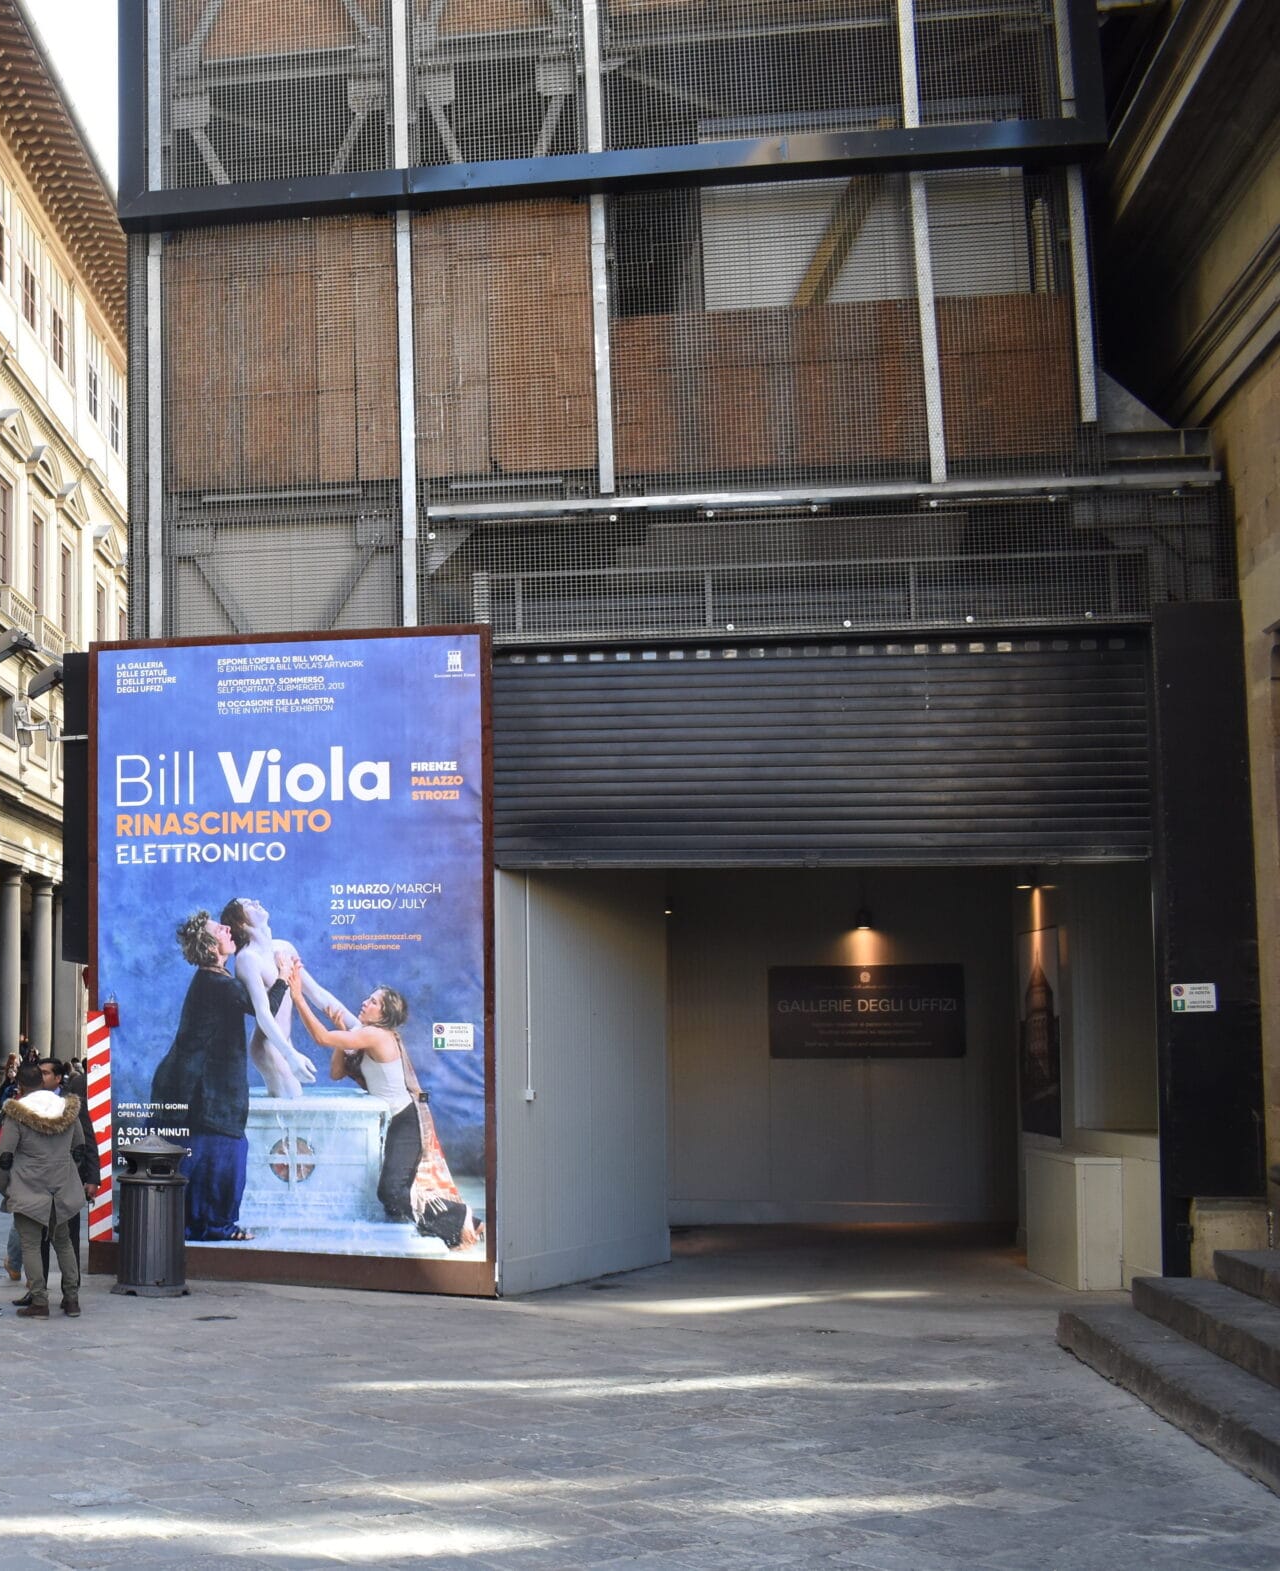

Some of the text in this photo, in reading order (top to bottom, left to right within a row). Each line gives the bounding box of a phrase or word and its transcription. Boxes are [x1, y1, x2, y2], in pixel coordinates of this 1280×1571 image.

[217, 658, 247, 666] ESPONE
[249, 656, 280, 664] L'OPERA
[309, 654, 334, 662] VIOLA
[226, 664, 268, 672] EXHIBITING
[294, 662, 322, 670] VIOLA'S
[324, 660, 364, 668] ARTWORK
[116, 670, 138, 678] DELLE
[147, 676, 176, 684] PITTURE
[217, 676, 324, 686] AUTORITRATTO, SOMMERSO
[277, 684, 326, 692] SUBMERGED,
[328, 682, 345, 690] 2013
[230, 707, 241, 715] TIE
[290, 704, 334, 712] EXHIBITION
[410, 761, 457, 772] FIRENZE
[116, 746, 390, 807] Bill Viola
[411, 775, 464, 786] PALAZZO
[412, 790, 459, 800] STROZZI
[116, 809, 331, 837] RINASCIMENTO
[116, 841, 286, 864] ELETTRONICO
[330, 885, 344, 894] 10
[330, 900, 344, 910] 23
[330, 914, 356, 925] 2017
[331, 933, 422, 941] www.palazzostrozzi.org
[777, 998, 957, 1013] GALLERIE DEGLI UFFIZI
[117, 1127, 125, 1135] A
[158, 1128, 190, 1136] MINUTI
[117, 1138, 131, 1146] DA
